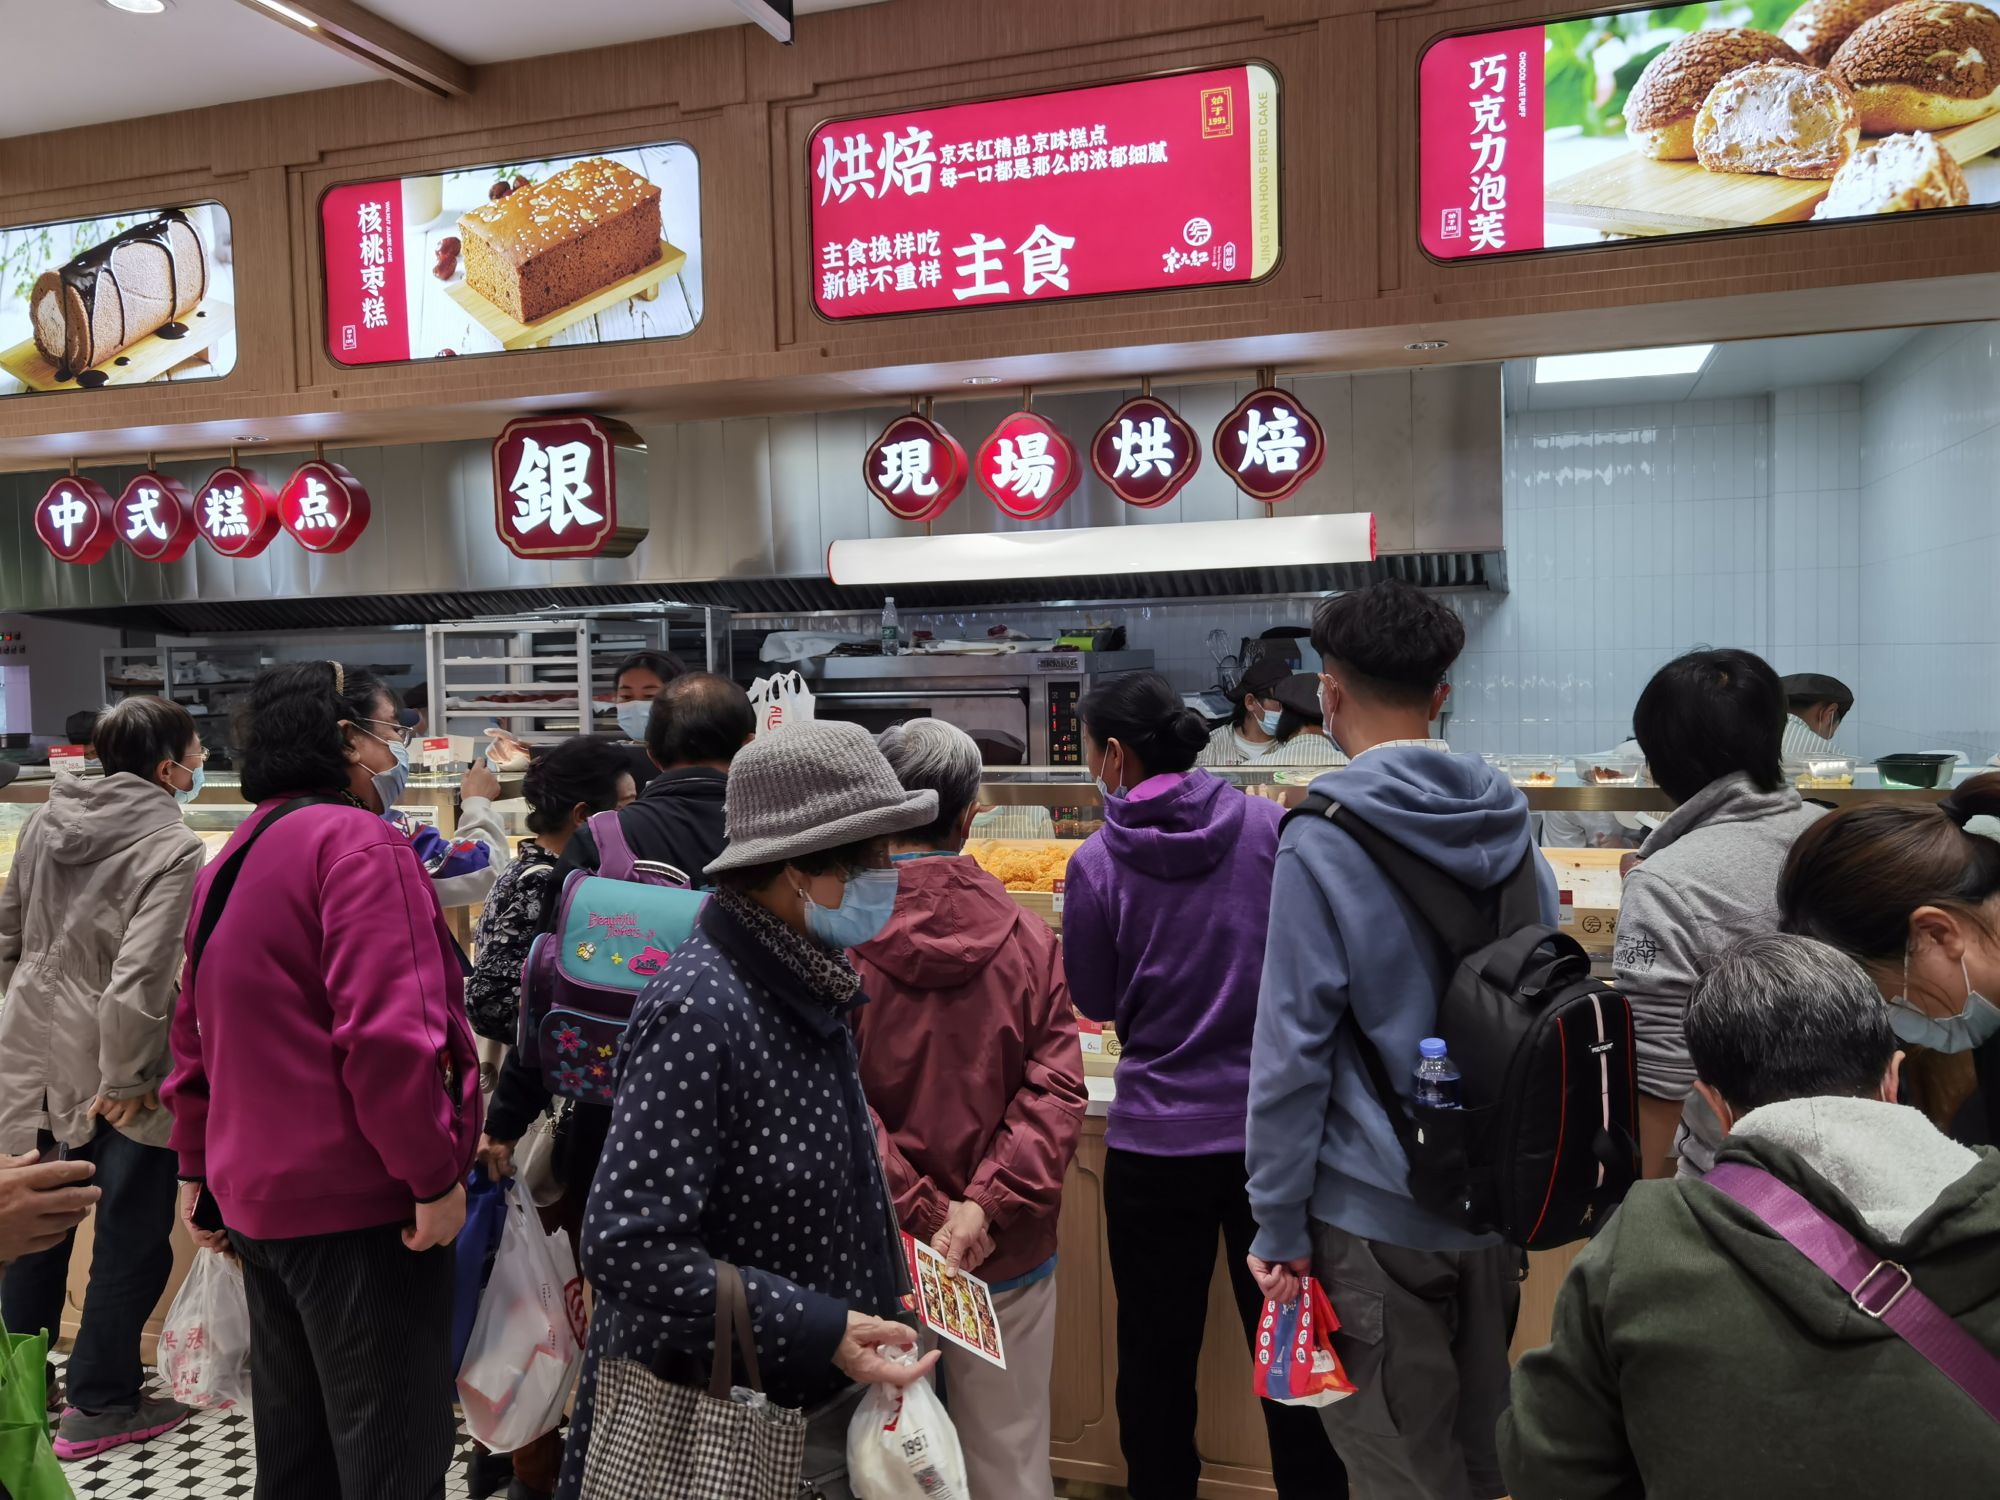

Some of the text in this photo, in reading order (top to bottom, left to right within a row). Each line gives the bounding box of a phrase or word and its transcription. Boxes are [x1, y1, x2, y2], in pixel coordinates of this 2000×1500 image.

[1518, 51, 1527, 118] CHOCOLATE PUFF
[817, 126, 937, 207] 烘焙
[939, 124, 1108, 165] 京天红精品京味糕点
[939, 140, 1168, 189] 每一口都是那么的浓郁细腻
[1258, 91, 1270, 264] JING TIAN HONG FRIED CAKE
[1468, 53, 1508, 252] 巧克力泡芙
[357, 202, 389, 329] 核桃枣糕
[822, 229, 942, 270] 主食换样吃
[822, 260, 942, 301] 新鲜不重样
[952, 224, 1076, 301] 主食
[47, 477, 338, 548] 中式糕点
[508, 436, 604, 535] 銀
[901, 1434, 929, 1458] 1991
